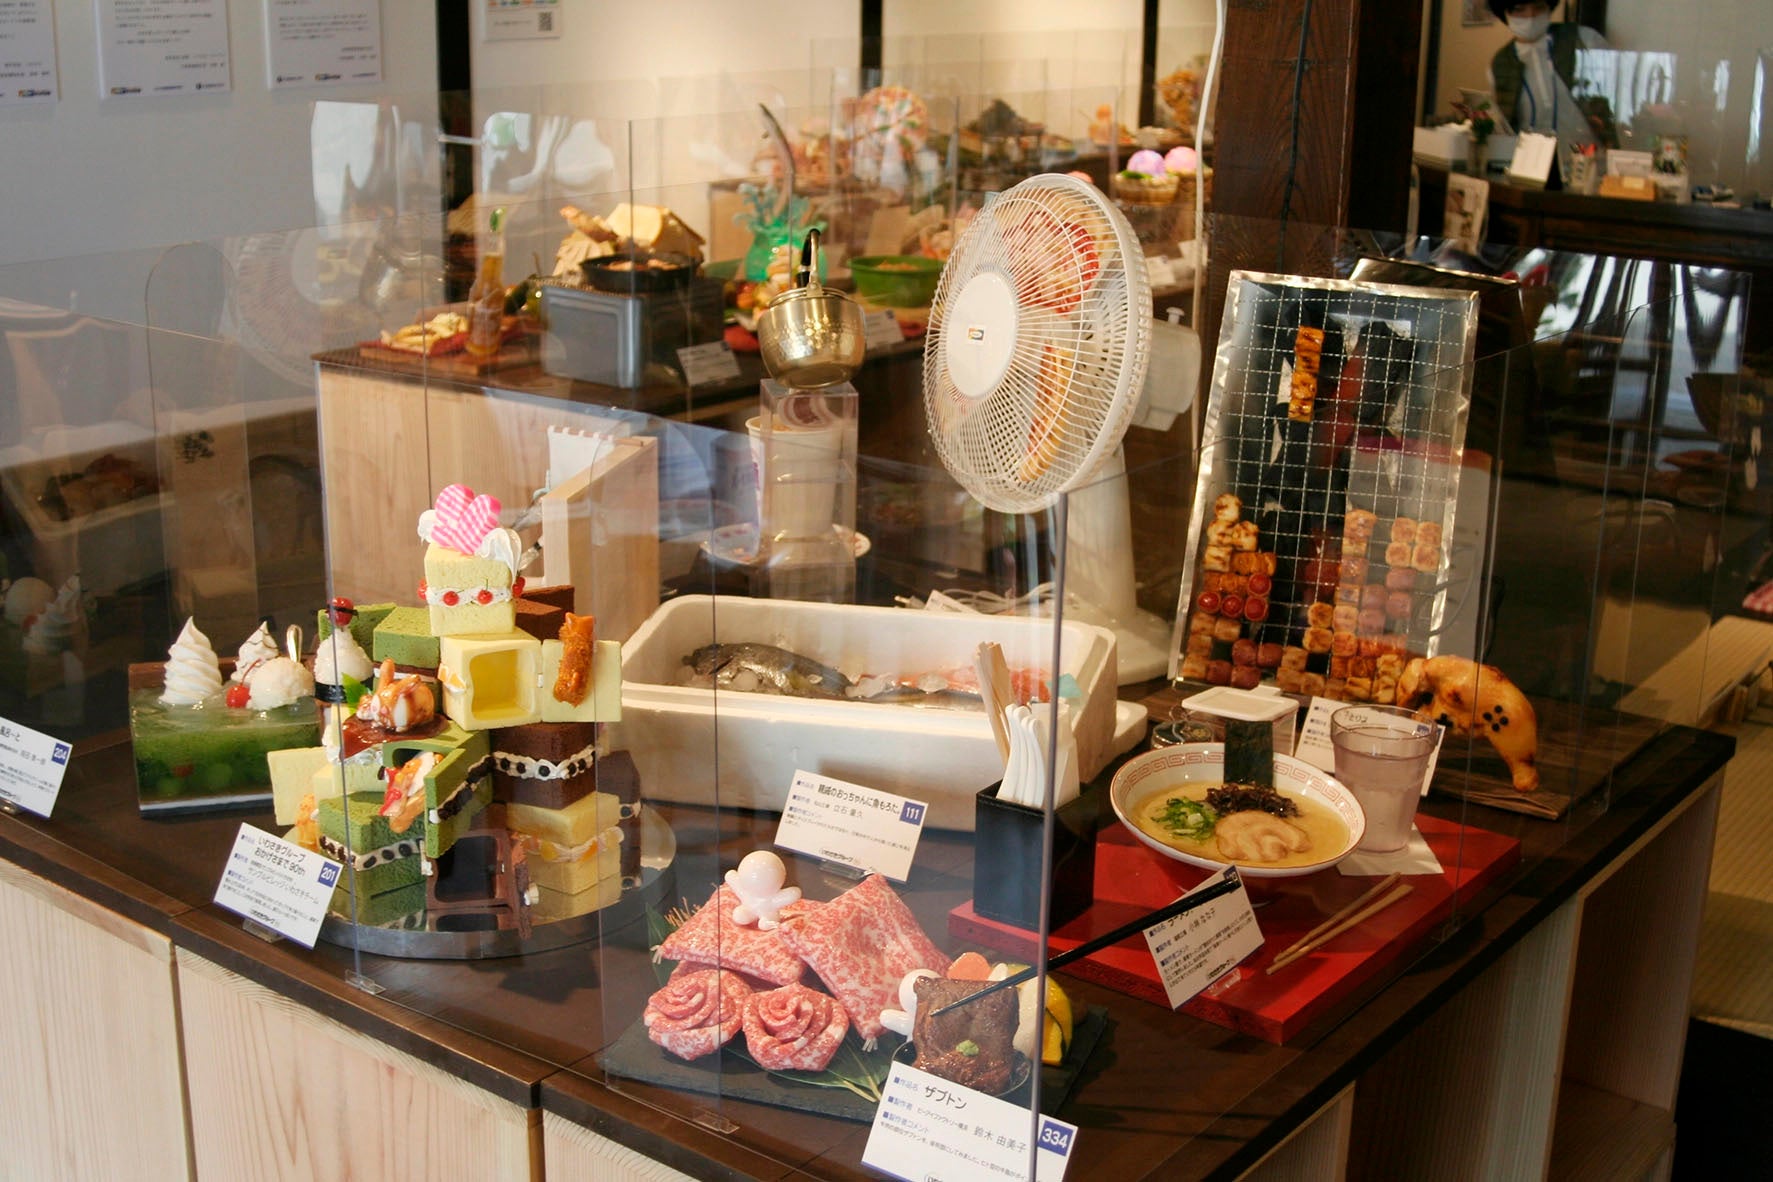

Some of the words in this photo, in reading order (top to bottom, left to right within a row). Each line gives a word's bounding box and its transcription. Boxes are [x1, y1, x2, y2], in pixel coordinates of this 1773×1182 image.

[905, 806, 920, 821] 111
[320, 867, 335, 882] 201
[924, 1085, 967, 1109] ザブトン
[996, 1135, 1027, 1153] 由美子
[1042, 1128, 1068, 1149] 334
